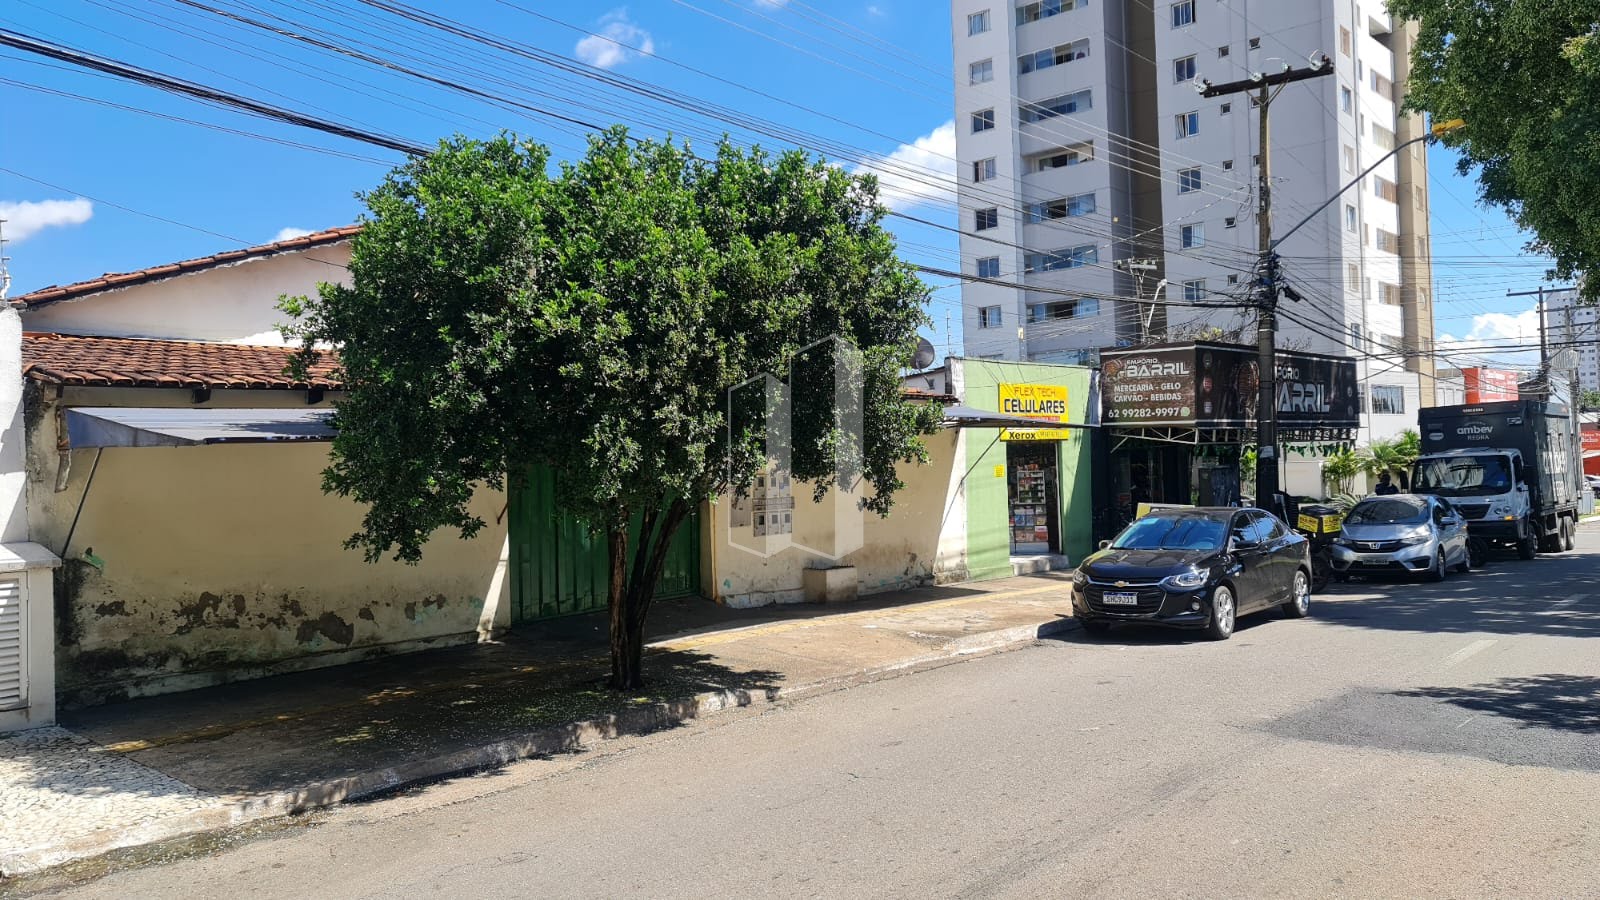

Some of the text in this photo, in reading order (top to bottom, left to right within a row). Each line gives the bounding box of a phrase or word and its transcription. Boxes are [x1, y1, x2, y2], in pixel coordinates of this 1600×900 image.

[1127, 362, 1190, 377] BARRIL
[1014, 386, 1056, 397] FLEX TECH
[1114, 383, 1154, 392] MERCEARIA
[1161, 382, 1181, 390] GELO
[1114, 392, 1143, 402] CARVÃO
[1150, 392, 1182, 401] BEBIDAS
[1277, 382, 1330, 412] ARRIL
[1004, 398, 1065, 414] CELULARES
[1108, 407, 1180, 418] 62 99282-9997
[1009, 431, 1036, 440] Xerox
[1457, 425, 1494, 435] ambev
